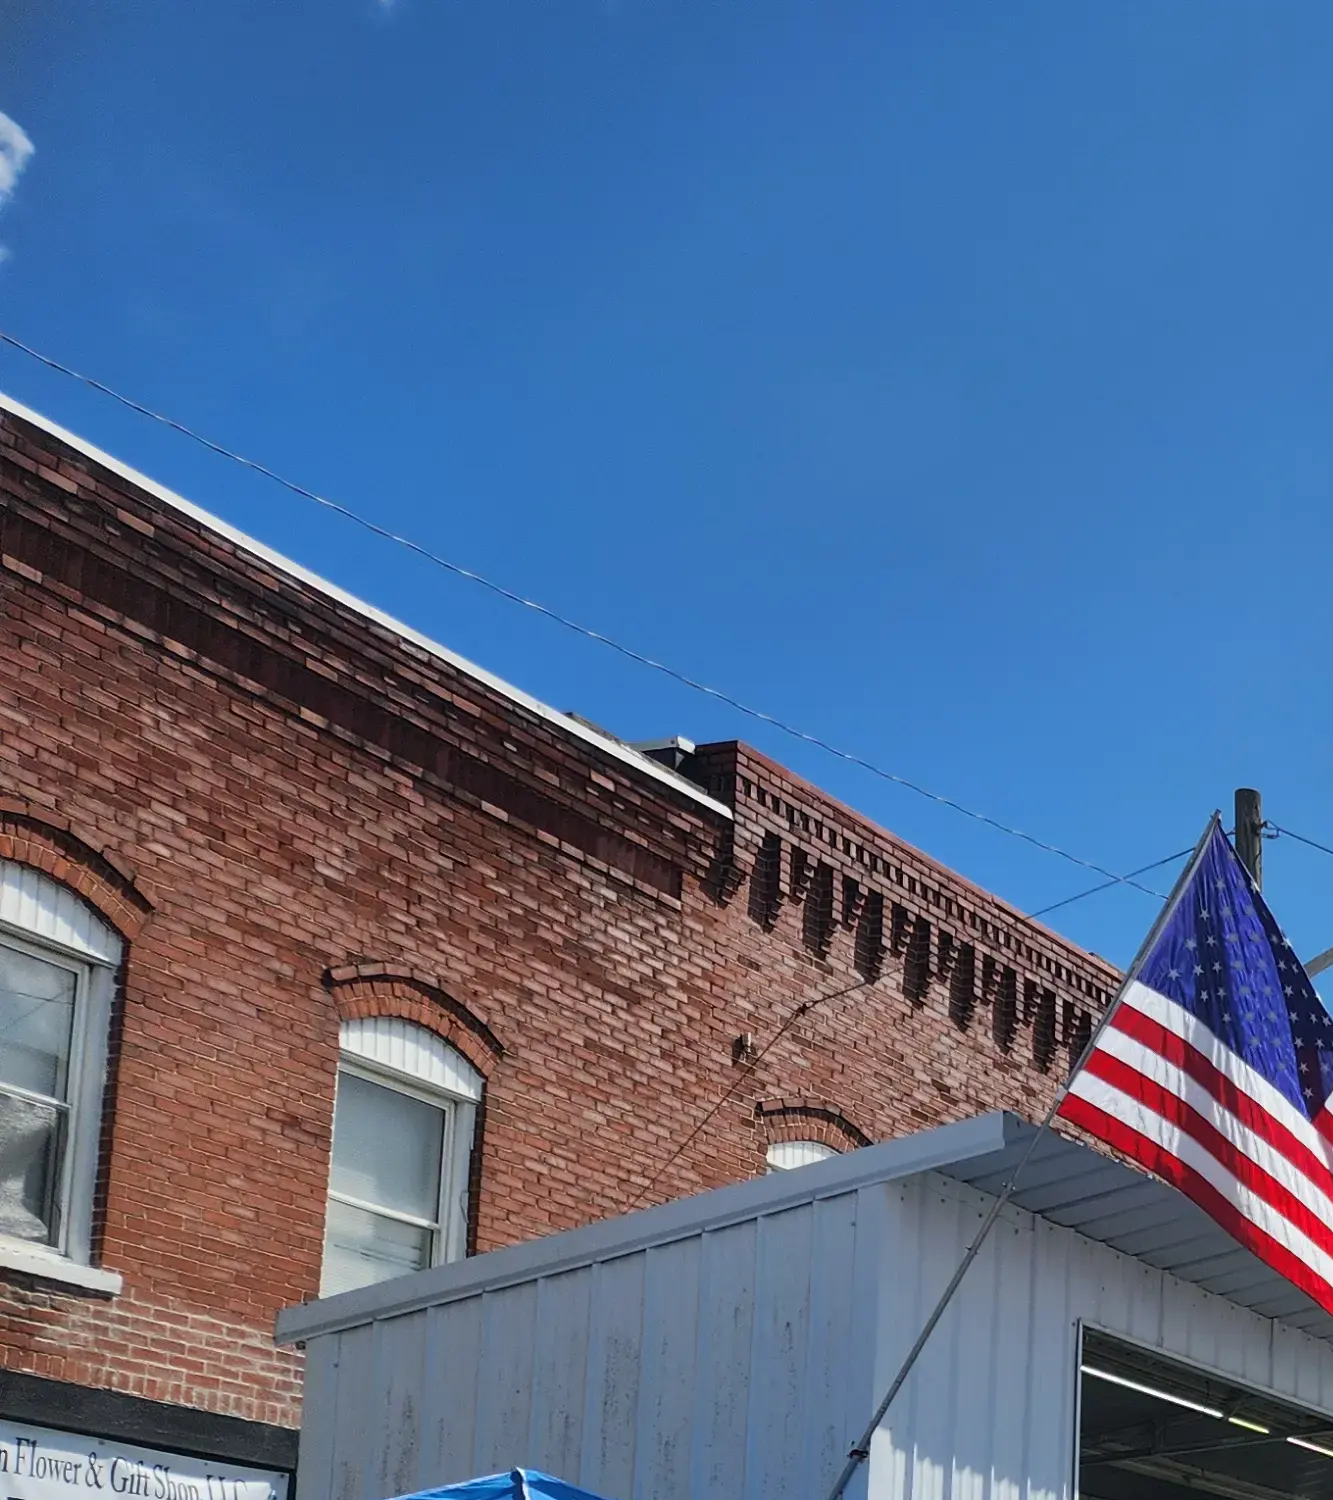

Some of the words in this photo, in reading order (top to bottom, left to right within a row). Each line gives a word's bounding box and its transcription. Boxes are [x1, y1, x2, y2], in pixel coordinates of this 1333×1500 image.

[15, 1437, 81, 1487] Flower
[85, 1452, 104, 1489] &
[110, 1457, 150, 1497] Gift
